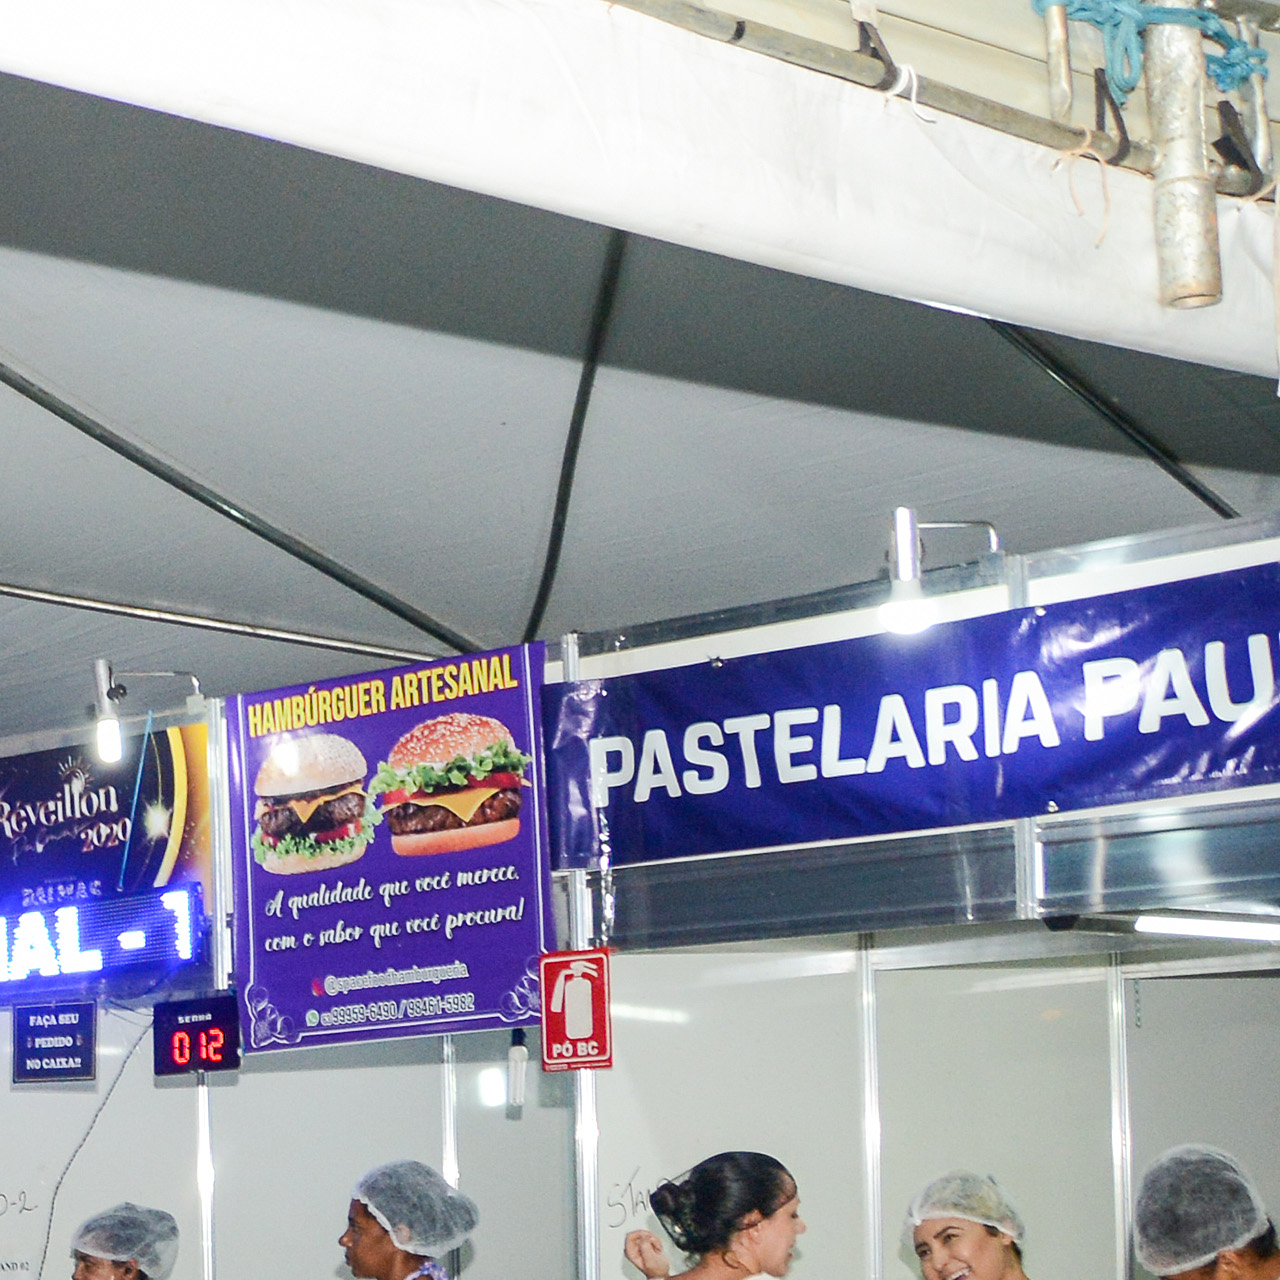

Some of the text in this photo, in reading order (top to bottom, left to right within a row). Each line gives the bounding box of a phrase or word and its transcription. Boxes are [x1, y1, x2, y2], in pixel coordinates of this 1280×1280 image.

[248, 654, 519, 738] HAMBÚRGUER ARTESANAL
[589, 633, 1280, 808] PASTELARIA PAU
[80, 817, 132, 853] 2020
[265, 889, 283, 917] A
[288, 878, 373, 919] qualidade
[379, 881, 411, 907] que
[415, 871, 451, 892] você
[160, 890, 193, 960] 1
[265, 897, 525, 952] com o sabor que você procura!
[29, 1013, 79, 1028] FAÇA SEU
[35, 1036, 73, 1048] PEDIDO
[172, 1027, 225, 1065] 012
[552, 1041, 599, 1058] PÓ BC
[26, 1059, 41, 1070] NO
